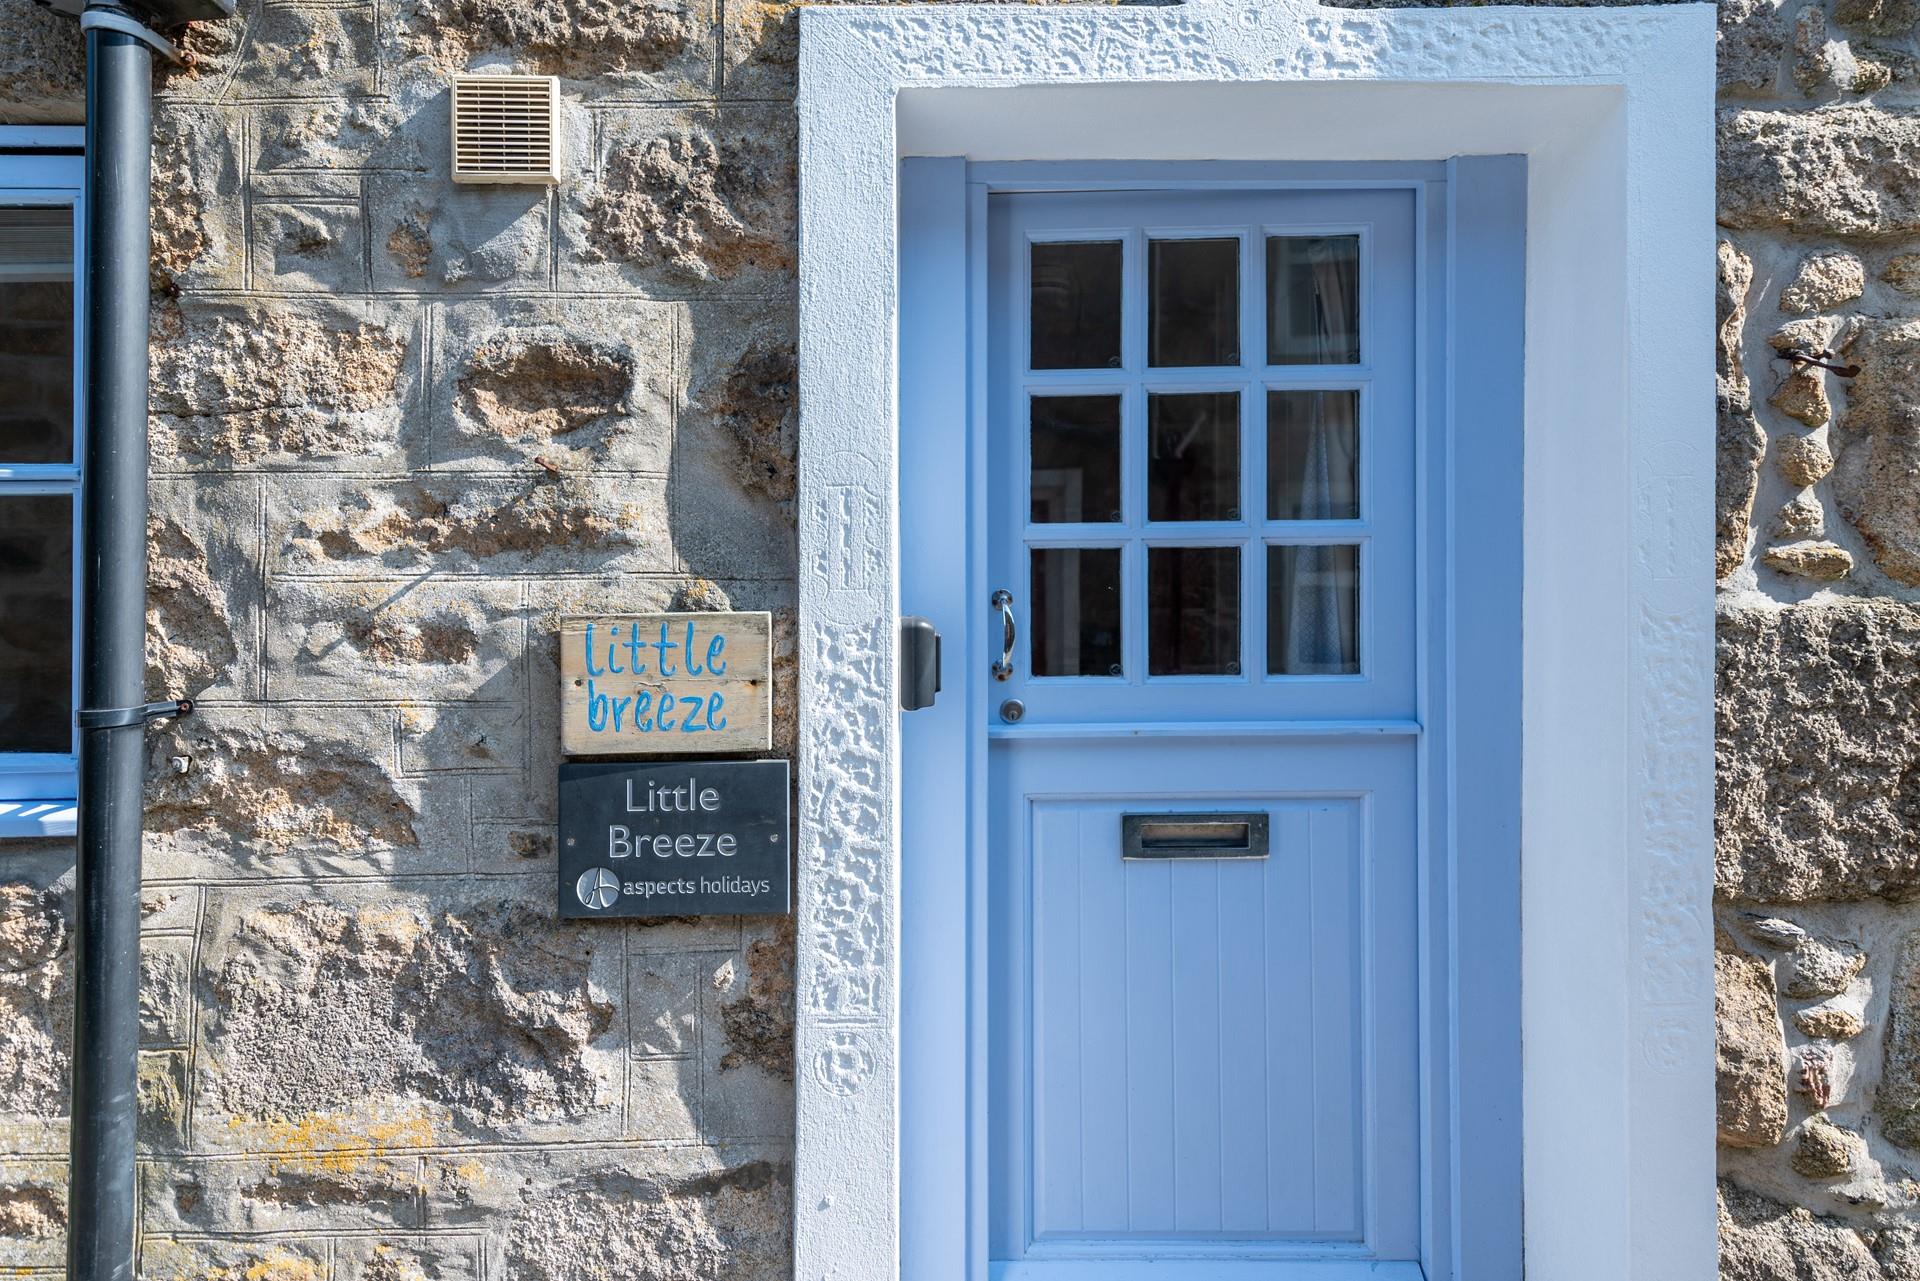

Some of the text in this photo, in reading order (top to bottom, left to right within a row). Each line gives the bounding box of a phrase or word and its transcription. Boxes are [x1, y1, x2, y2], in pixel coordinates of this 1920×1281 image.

[585, 621, 727, 677] little
[588, 679, 727, 733] breeze
[626, 778, 720, 812] Little
[609, 825, 737, 858] Breeze
[623, 877, 696, 898] aspects
[700, 876, 770, 896] holidays
